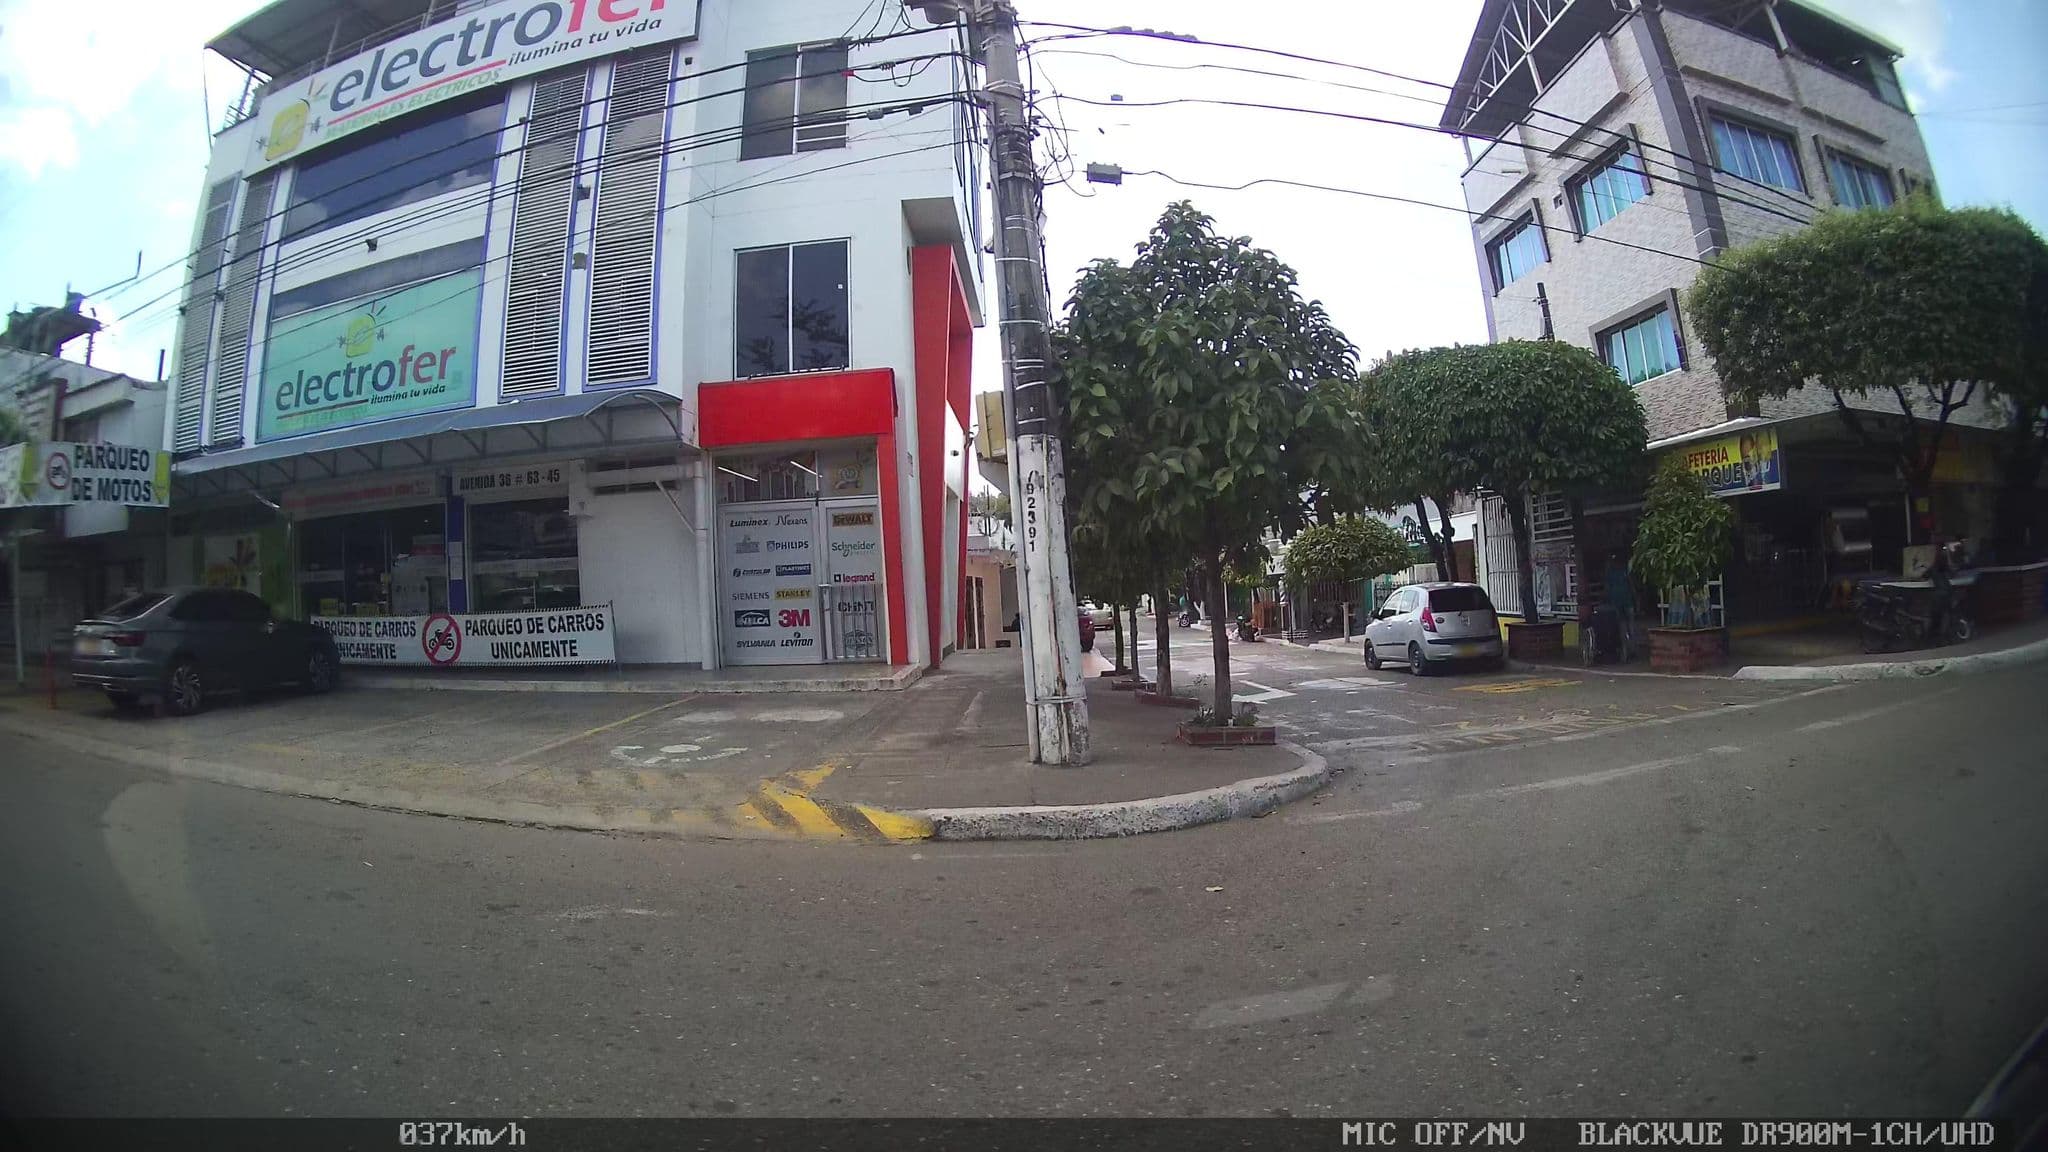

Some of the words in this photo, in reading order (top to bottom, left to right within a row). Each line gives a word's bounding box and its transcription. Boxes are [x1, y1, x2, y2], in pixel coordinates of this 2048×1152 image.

[507, 37, 581, 66] ilumina
[589, 28, 609, 43] tu
[615, 18, 662, 38] vida
[276, 344, 456, 411] electrofer
[370, 390, 407, 405] ilumina
[409, 389, 421, 399] tu
[423, 383, 446, 394] vida
[74, 444, 150, 472] PARQUEO
[1681, 444, 1729, 468] AFETERÍA
[1693, 462, 1743, 489] ARQUE
[72, 477, 92, 500] DE
[97, 478, 152, 502] MOTOS
[730, 519, 768, 527] Luminex
[775, 541, 809, 550] PHILIPS
[843, 573, 875, 582] legrand
[732, 592, 770, 600] SIEMENS
[776, 590, 811, 598] STANLEY
[465, 617, 522, 636] PARQUEO
[526, 617, 544, 634] DE
[548, 613, 604, 633] CARROS
[779, 609, 810, 627] 3M
[359, 621, 372, 637] DE
[375, 620, 416, 637] CARROS
[336, 643, 396, 659] NICAMENTE
[491, 640, 578, 659] UNICAMENTE
[737, 639, 776, 648] SYLVANIA
[781, 638, 813, 647] LEVITON
